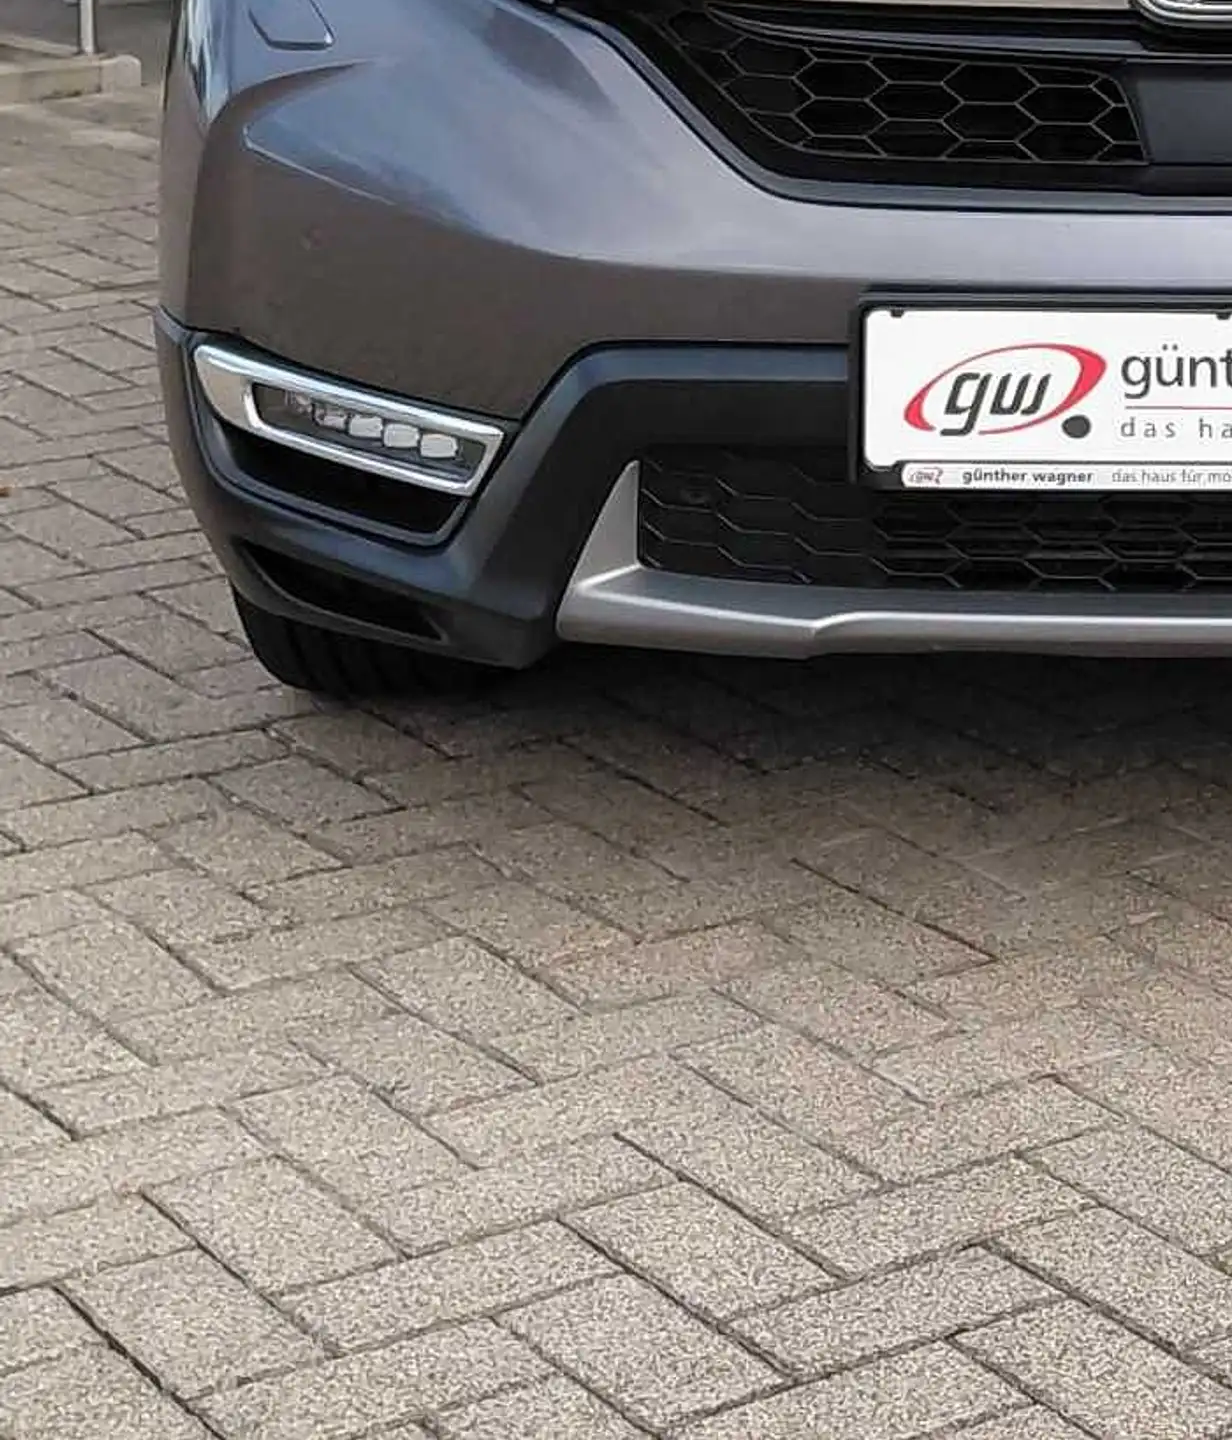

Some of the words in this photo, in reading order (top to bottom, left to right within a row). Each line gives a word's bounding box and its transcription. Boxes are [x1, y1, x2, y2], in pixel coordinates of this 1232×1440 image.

[1120, 416, 1176, 438] das
[963, 467, 1027, 485] günther
[1032, 470, 1094, 485] wagner
[1111, 469, 1136, 483] das
[1141, 469, 1176, 483] haus
[1181, 469, 1202, 483] für
